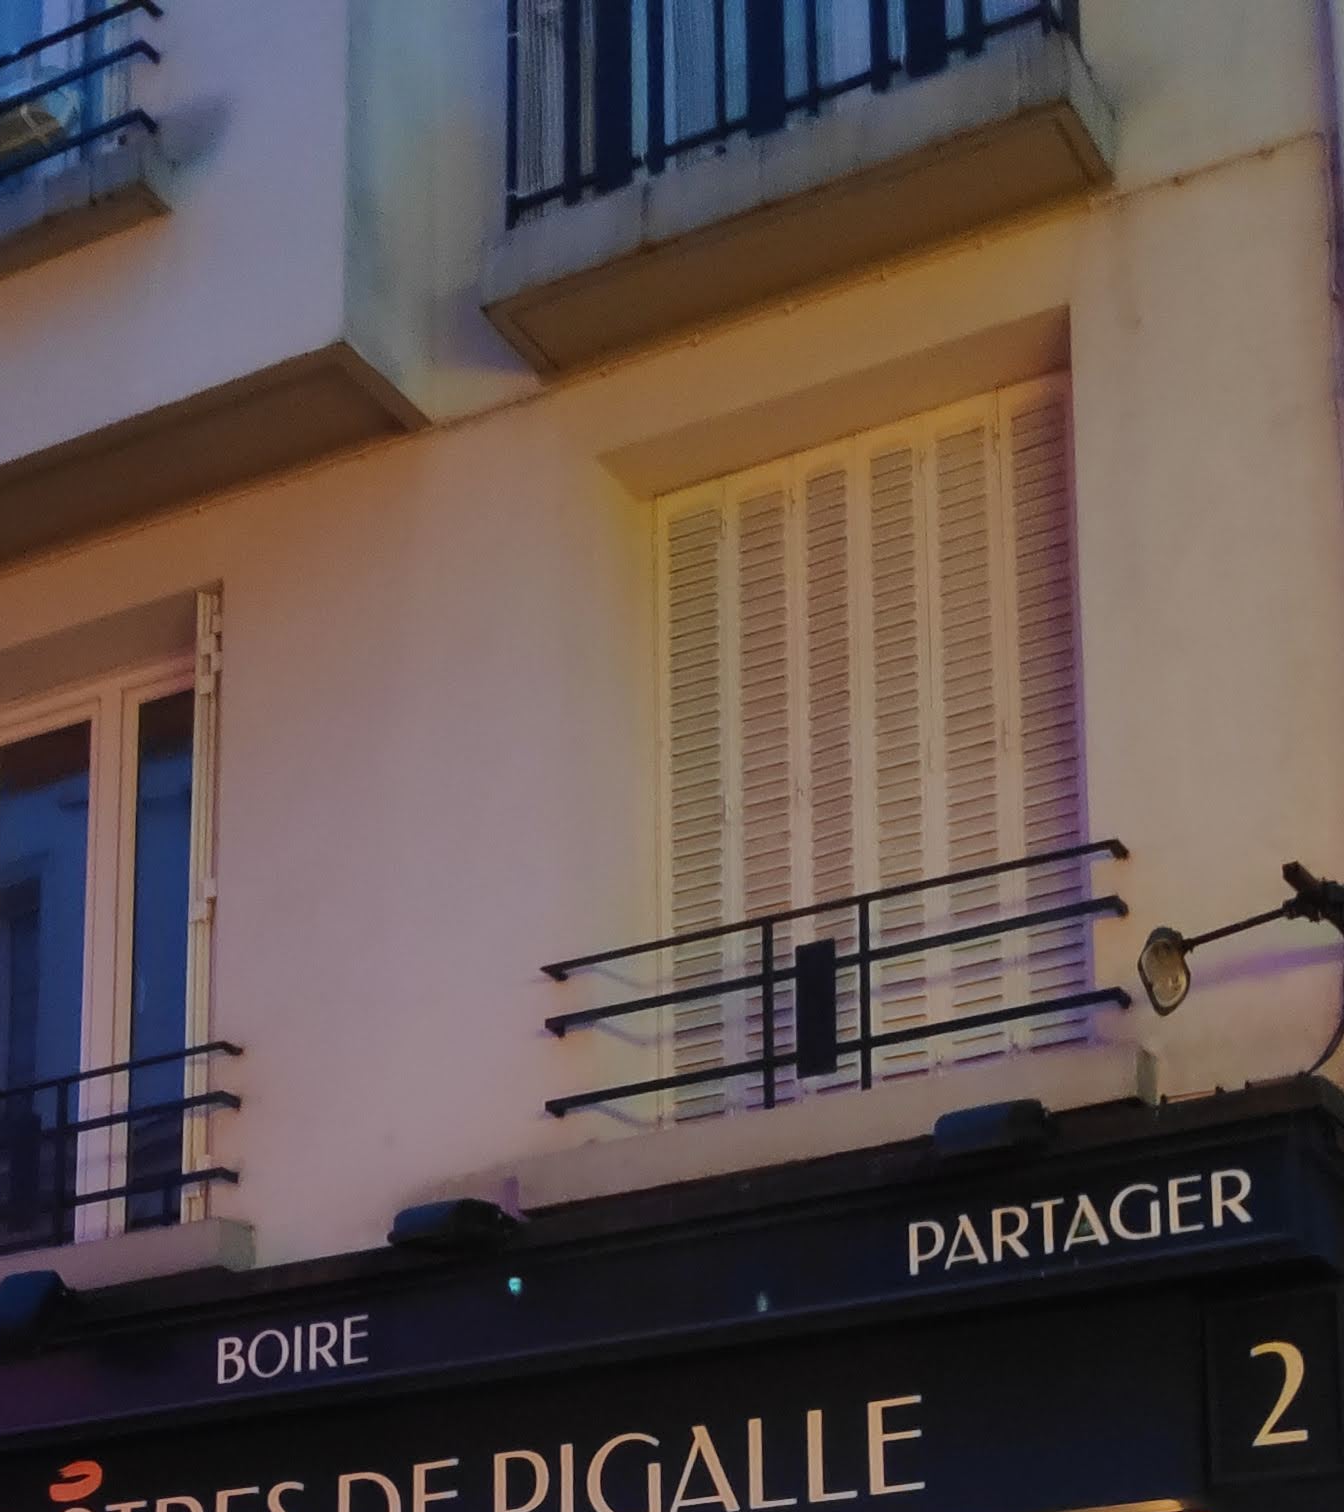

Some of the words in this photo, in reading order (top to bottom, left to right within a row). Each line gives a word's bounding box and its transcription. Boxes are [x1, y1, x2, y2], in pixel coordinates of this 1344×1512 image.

[908, 1169, 1252, 1276] PARTAGER
[216, 1314, 369, 1386] BOIRE
[1249, 1341, 1309, 1447] 2
